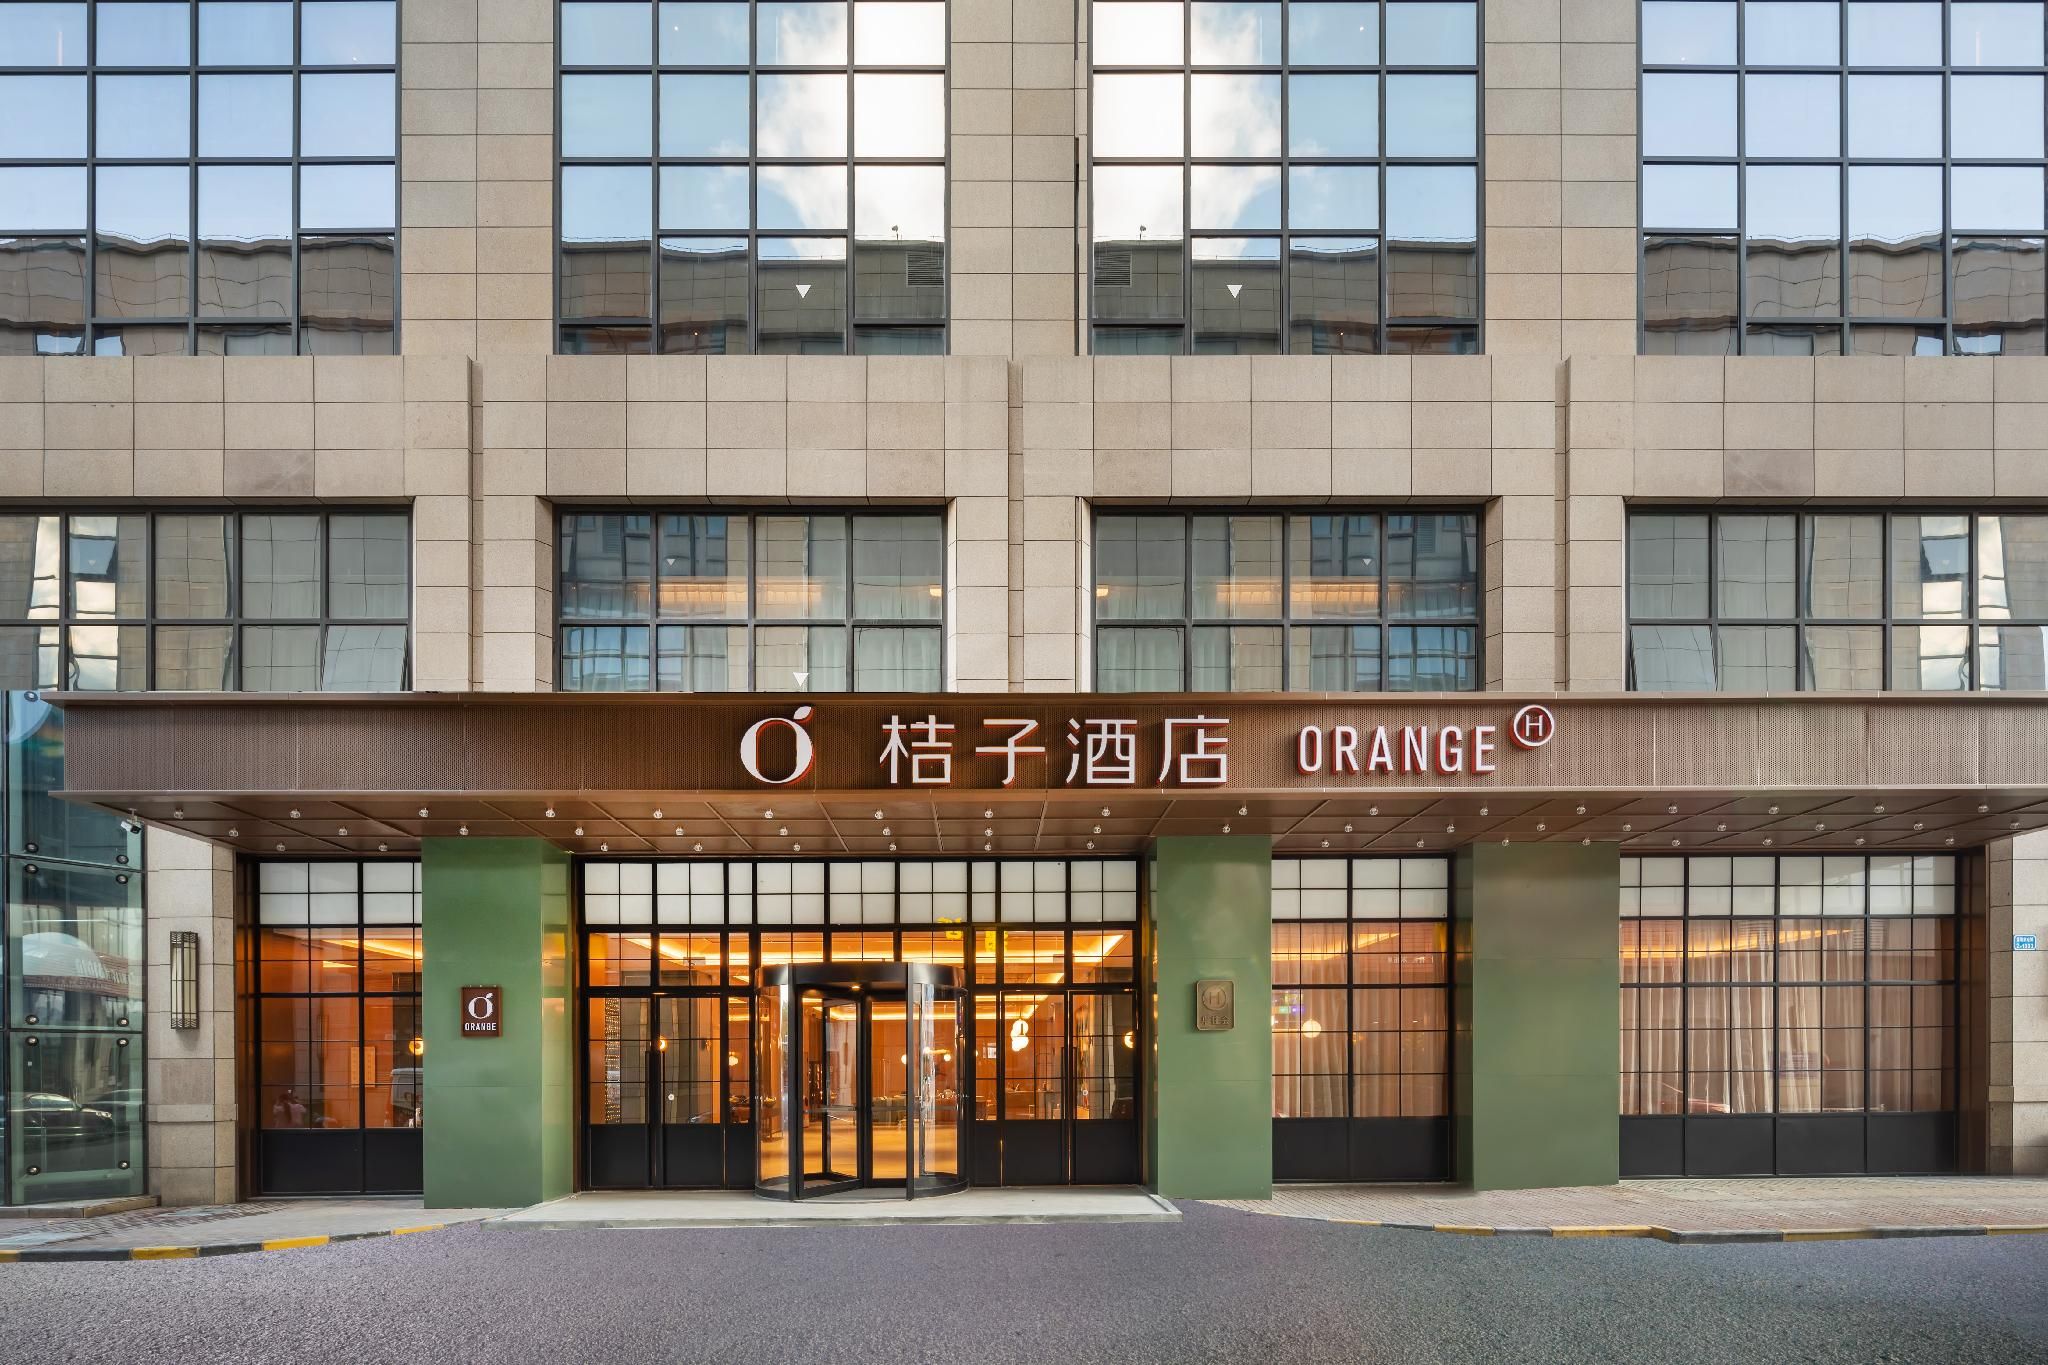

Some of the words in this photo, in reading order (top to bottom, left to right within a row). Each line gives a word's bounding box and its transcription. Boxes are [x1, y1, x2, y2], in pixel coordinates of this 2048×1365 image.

[879, 715, 1230, 785] 桔子酒店
[1300, 725, 1496, 772] ORANGE
[464, 1022, 497, 1030] ORANGE
